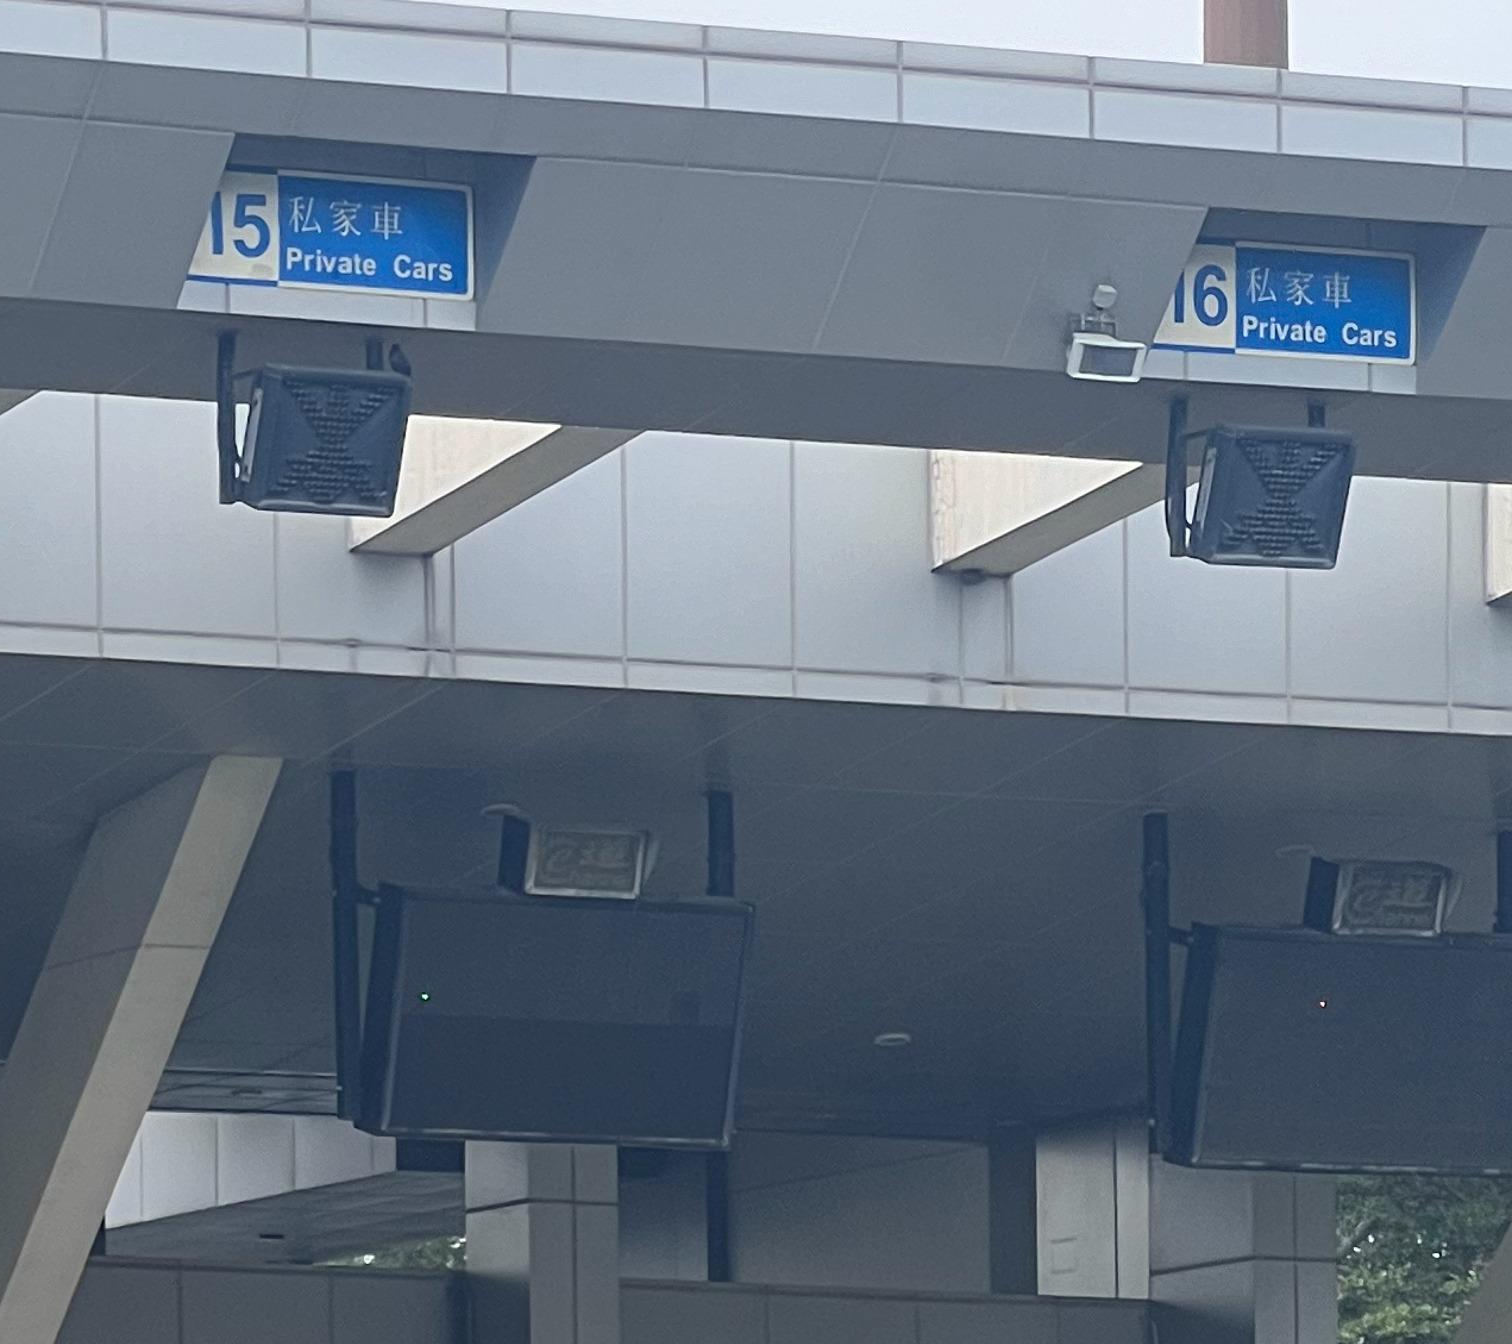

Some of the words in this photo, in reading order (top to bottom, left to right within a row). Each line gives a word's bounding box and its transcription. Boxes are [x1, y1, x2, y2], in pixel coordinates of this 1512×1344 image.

[289, 195, 404, 240] 私家車
[286, 247, 377, 276] Private
[393, 254, 453, 282] Cars
[1246, 266, 1352, 309] 私家車
[1242, 315, 1327, 344] Private
[1341, 323, 1397, 348] Cars
